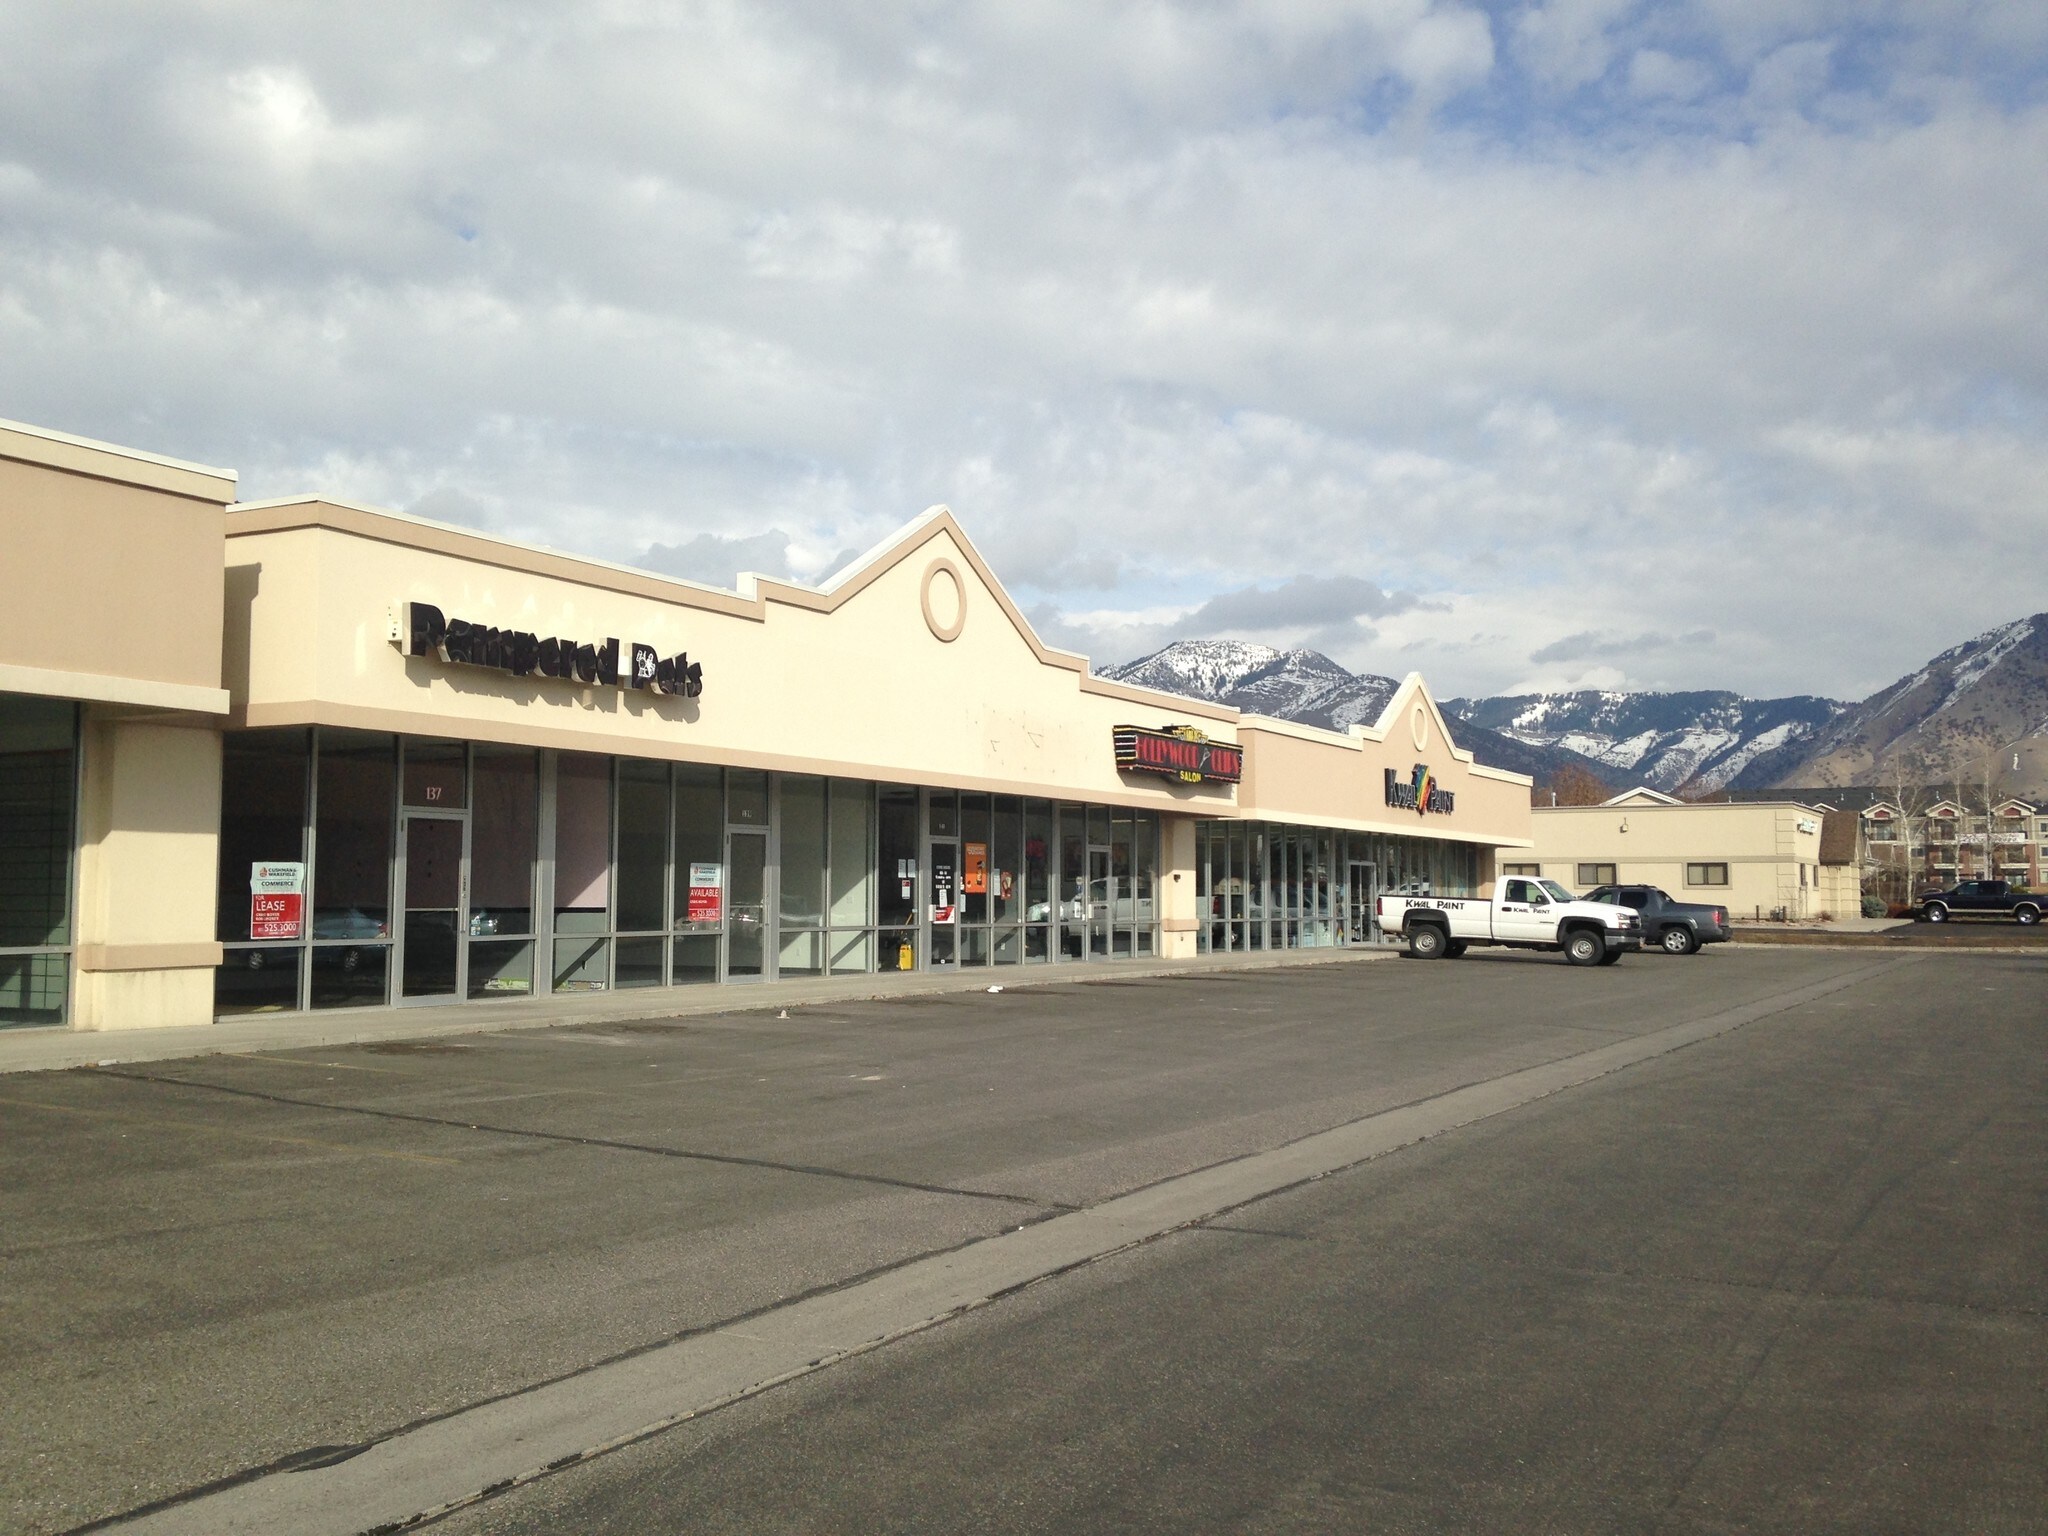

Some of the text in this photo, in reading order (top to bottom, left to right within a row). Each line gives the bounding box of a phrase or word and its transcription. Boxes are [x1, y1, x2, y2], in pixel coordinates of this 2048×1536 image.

[402, 601, 703, 698] Pampered Pets
[1180, 770, 1201, 783] SALON
[426, 787, 441, 800] 137
[690, 889, 719, 897] AVAILABLE
[256, 901, 285, 911] LEASE
[1437, 901, 1465, 910] PAINT
